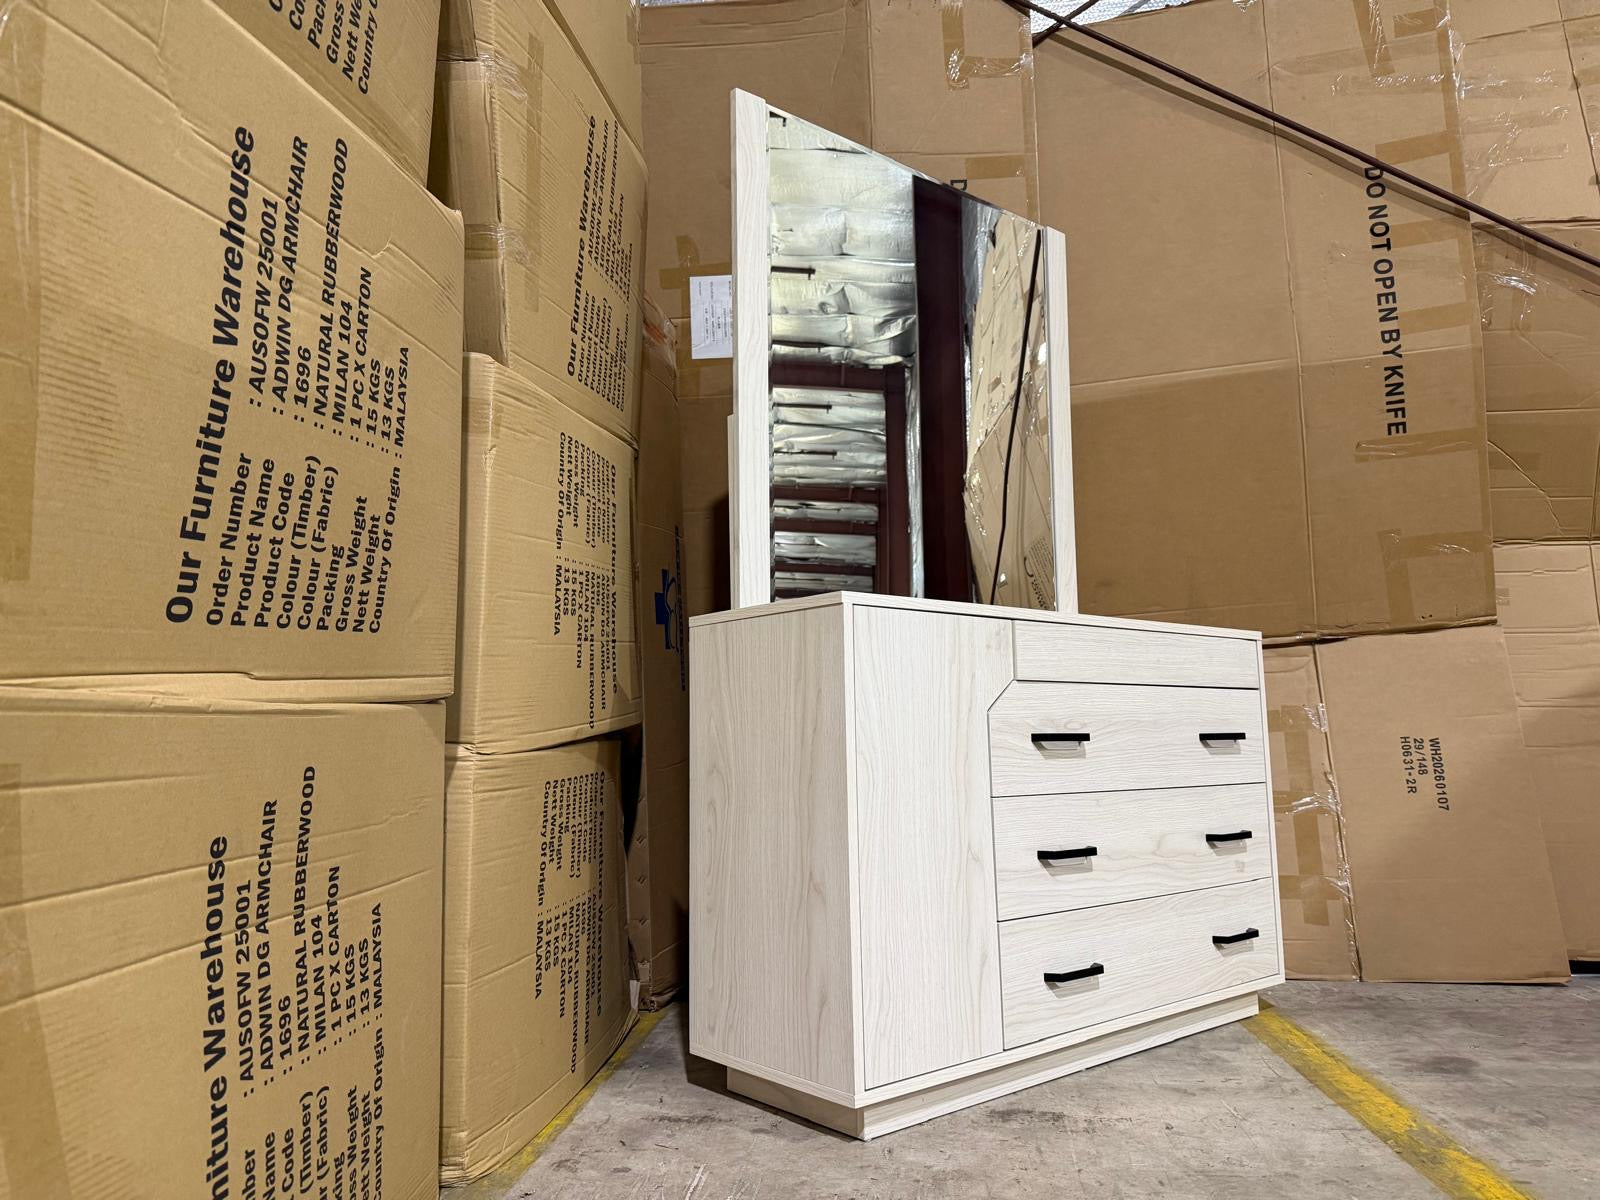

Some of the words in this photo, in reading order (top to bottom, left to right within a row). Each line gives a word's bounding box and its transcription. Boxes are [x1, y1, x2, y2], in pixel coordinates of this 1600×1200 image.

[289, 0, 306, 30] Co
[326, 0, 344, 64] Gross
[342, 31, 358, 82] Nett
[358, 10, 377, 94] Country
[282, 136, 308, 275] ARMCHAIR
[579, 115, 596, 232] Warehouse
[1364, 166, 1387, 199] DO
[212, 127, 255, 346] Warehouse
[257, 197, 278, 281] 25001
[321, 138, 348, 307] RUBBERWOOD
[1368, 204, 1391, 251] NOT
[278, 275, 294, 313] DG
[355, 266, 371, 356] CARTON
[570, 237, 585, 335] Furniture
[1374, 259, 1398, 322] OPEN
[249, 281, 271, 395] AUSOFW
[338, 300, 352, 345] 104
[567, 338, 577, 376] Our
[1381, 329, 1403, 358] BY
[272, 316, 291, 404] ADWIN
[313, 313, 333, 416] NATURAL
[332, 349, 349, 424] MILAN
[352, 379, 364, 411] PC
[354, 359, 365, 377] X
[369, 358, 381, 404] KGS
[383, 366, 394, 410] KGS
[350, 417, 362, 429] 1
[366, 408, 378, 435] 15
[381, 415, 392, 441] 13
[394, 347, 409, 447] MALAYSIA
[1384, 365, 1407, 436] KNIFE
[179, 359, 235, 541] Furniture
[557, 432, 566, 487] Country
[219, 453, 251, 550] Number
[248, 459, 274, 527] Name
[253, 536, 284, 627] Product
[272, 473, 294, 531] Code
[294, 345, 311, 408] 1696
[290, 456, 321, 549] (Timber)
[310, 466, 339, 553] (Fabric)
[385, 467, 400, 525] Origin
[558, 490, 565, 507] Of
[345, 496, 367, 568] Weight
[360, 514, 381, 585] Weight
[381, 528, 393, 552] Of
[556, 509, 564, 550] Origin
[166, 551, 201, 623] Our
[206, 556, 233, 625] Order
[230, 532, 262, 626] Product
[276, 554, 301, 629] Colour
[297, 558, 321, 630] Colour
[316, 544, 345, 631] Packing
[335, 574, 355, 632] Gross
[369, 556, 391, 633] Country
[554, 564, 562, 636] MALAYSIA
[564, 567, 570, 583] 13
[352, 589, 370, 632] Nett
[1400, 736, 1417, 794] H0631-2R
[1413, 738, 1428, 775] 29/148
[1429, 738, 1449, 811] WH20260107
[540, 781, 551, 838] Country
[255, 800, 277, 934] ARMCHAIR
[293, 766, 315, 936] RUBBERWOOD
[537, 861, 546, 906] Origin
[234, 880, 251, 965] 25001
[311, 914, 324, 958] 104
[326, 866, 340, 956] CARTON
[200, 836, 227, 1072] Warehouse
[256, 941, 271, 980] DG
[329, 960, 340, 978] X
[344, 944, 355, 991] KGS
[359, 938, 369, 983] KGS
[372, 902, 382, 1010] MALAYSIA
[535, 920, 544, 1000] MALAYSIA
[236, 972, 254, 1081] AUSOFW
[258, 984, 274, 1070] ADWIN
[278, 995, 292, 1060] 1696
[295, 940, 310, 1052] NATURAL
[313, 965, 326, 1043] MILAN
[330, 981, 341, 1013] PC
[331, 1016, 342, 1031] 1
[346, 995, 356, 1023] 15
[360, 988, 370, 1015] 13
[374, 1027, 384, 1092] Origin
[299, 1091, 314, 1194] (Timber)
[316, 1086, 330, 1180] (Fabric)
[347, 1085, 359, 1168] Weight
[361, 1091, 372, 1171] Weight
[373, 1096, 382, 1120] Of
[281, 1128, 294, 1193] Code
